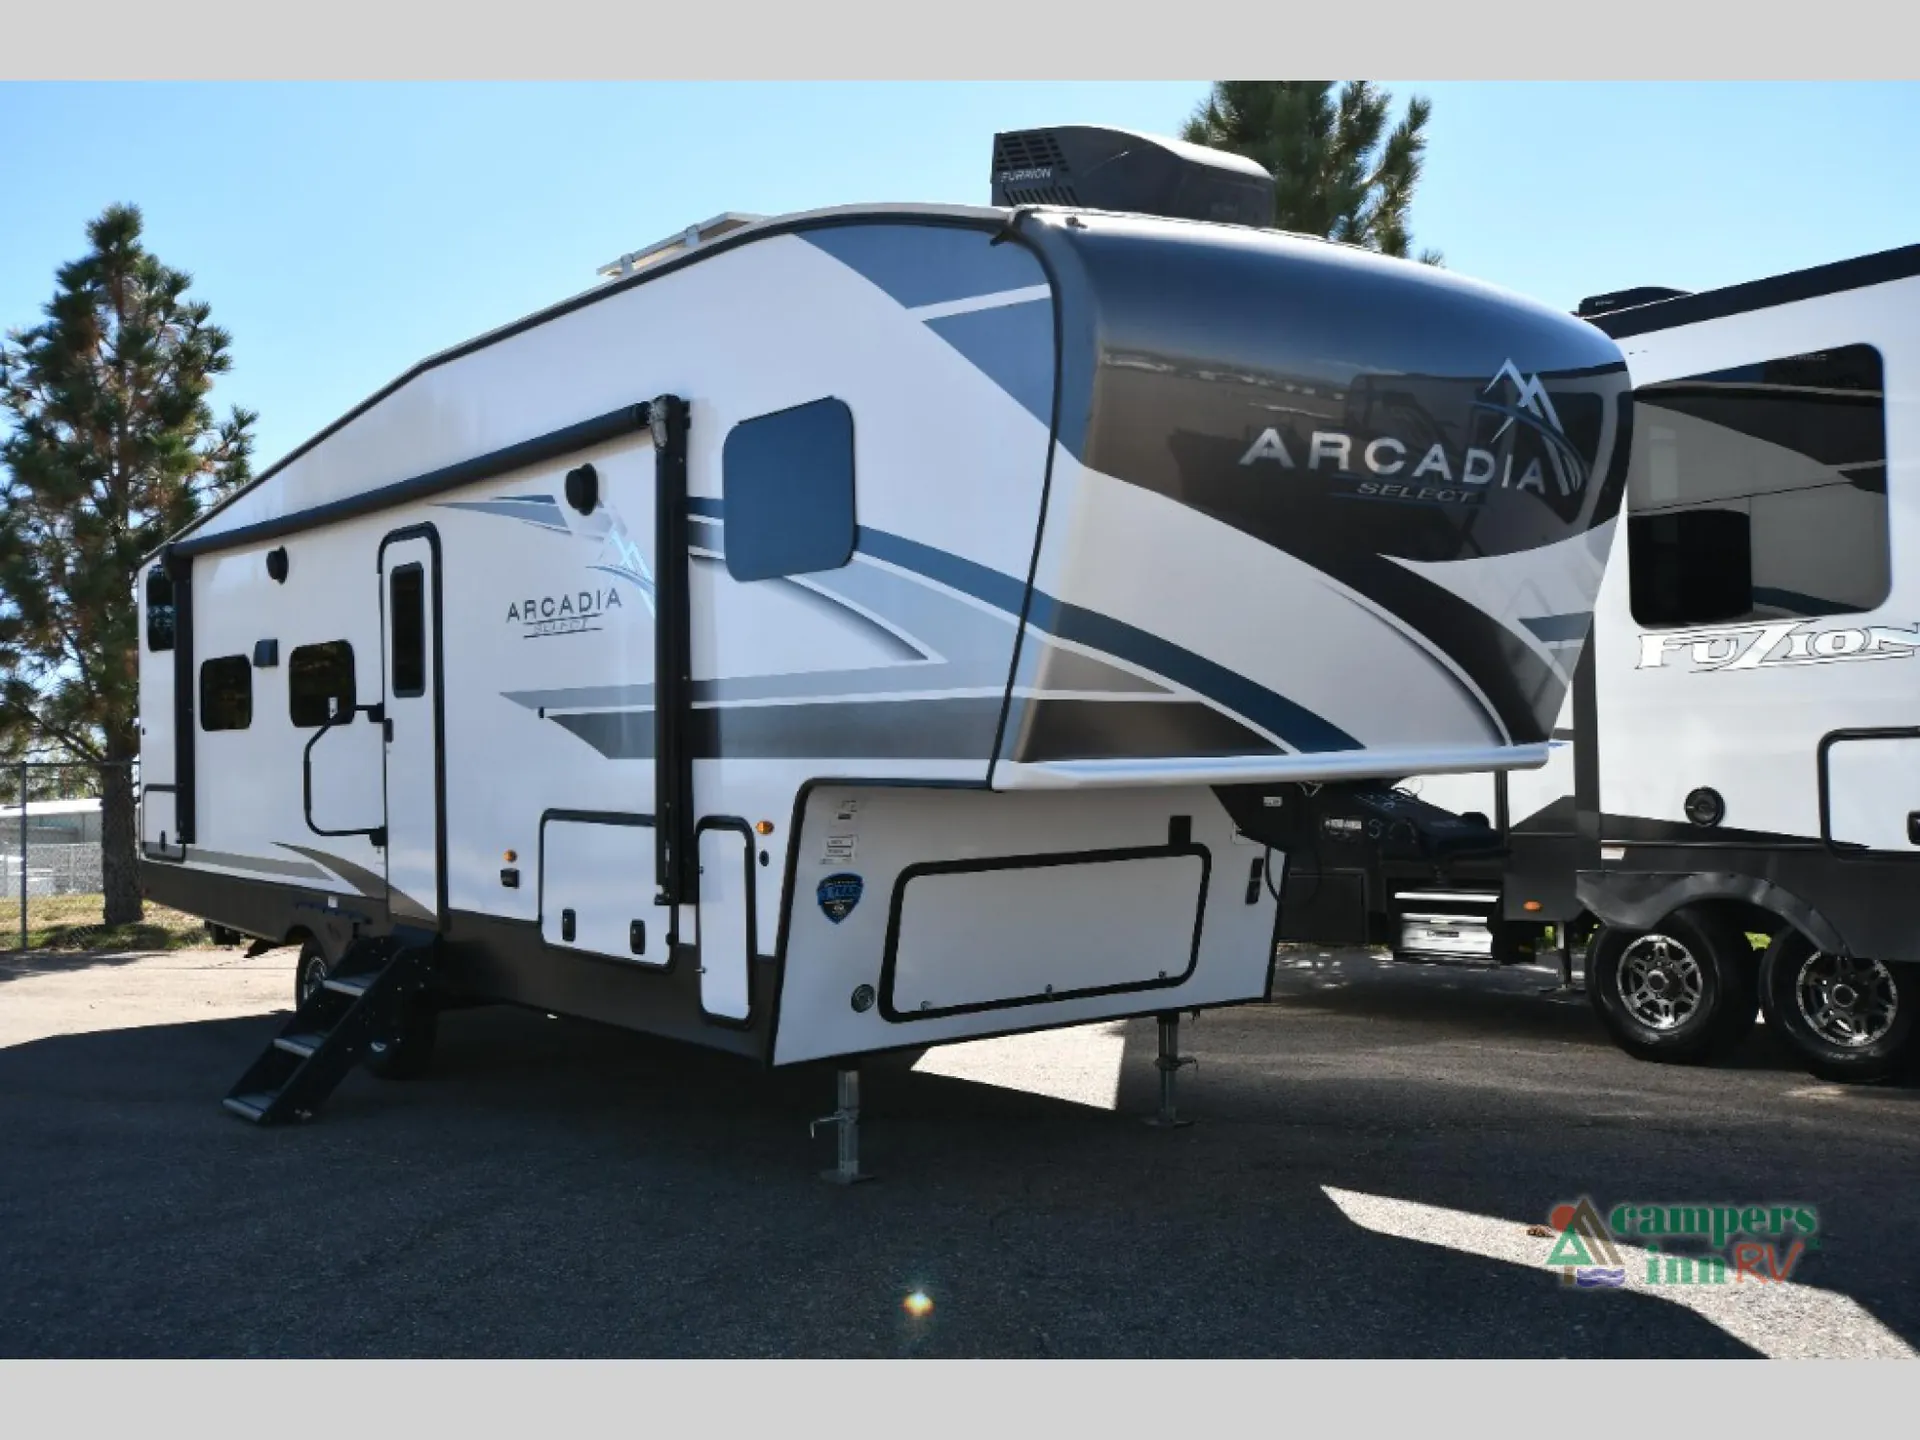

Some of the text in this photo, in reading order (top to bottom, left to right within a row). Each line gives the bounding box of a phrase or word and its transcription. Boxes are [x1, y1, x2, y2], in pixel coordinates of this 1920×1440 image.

[1000, 167, 1052, 183] FURRION
[1238, 427, 1546, 495] ARCADIA
[1356, 482, 1479, 504] SELECT
[506, 587, 623, 623] ARCADIA
